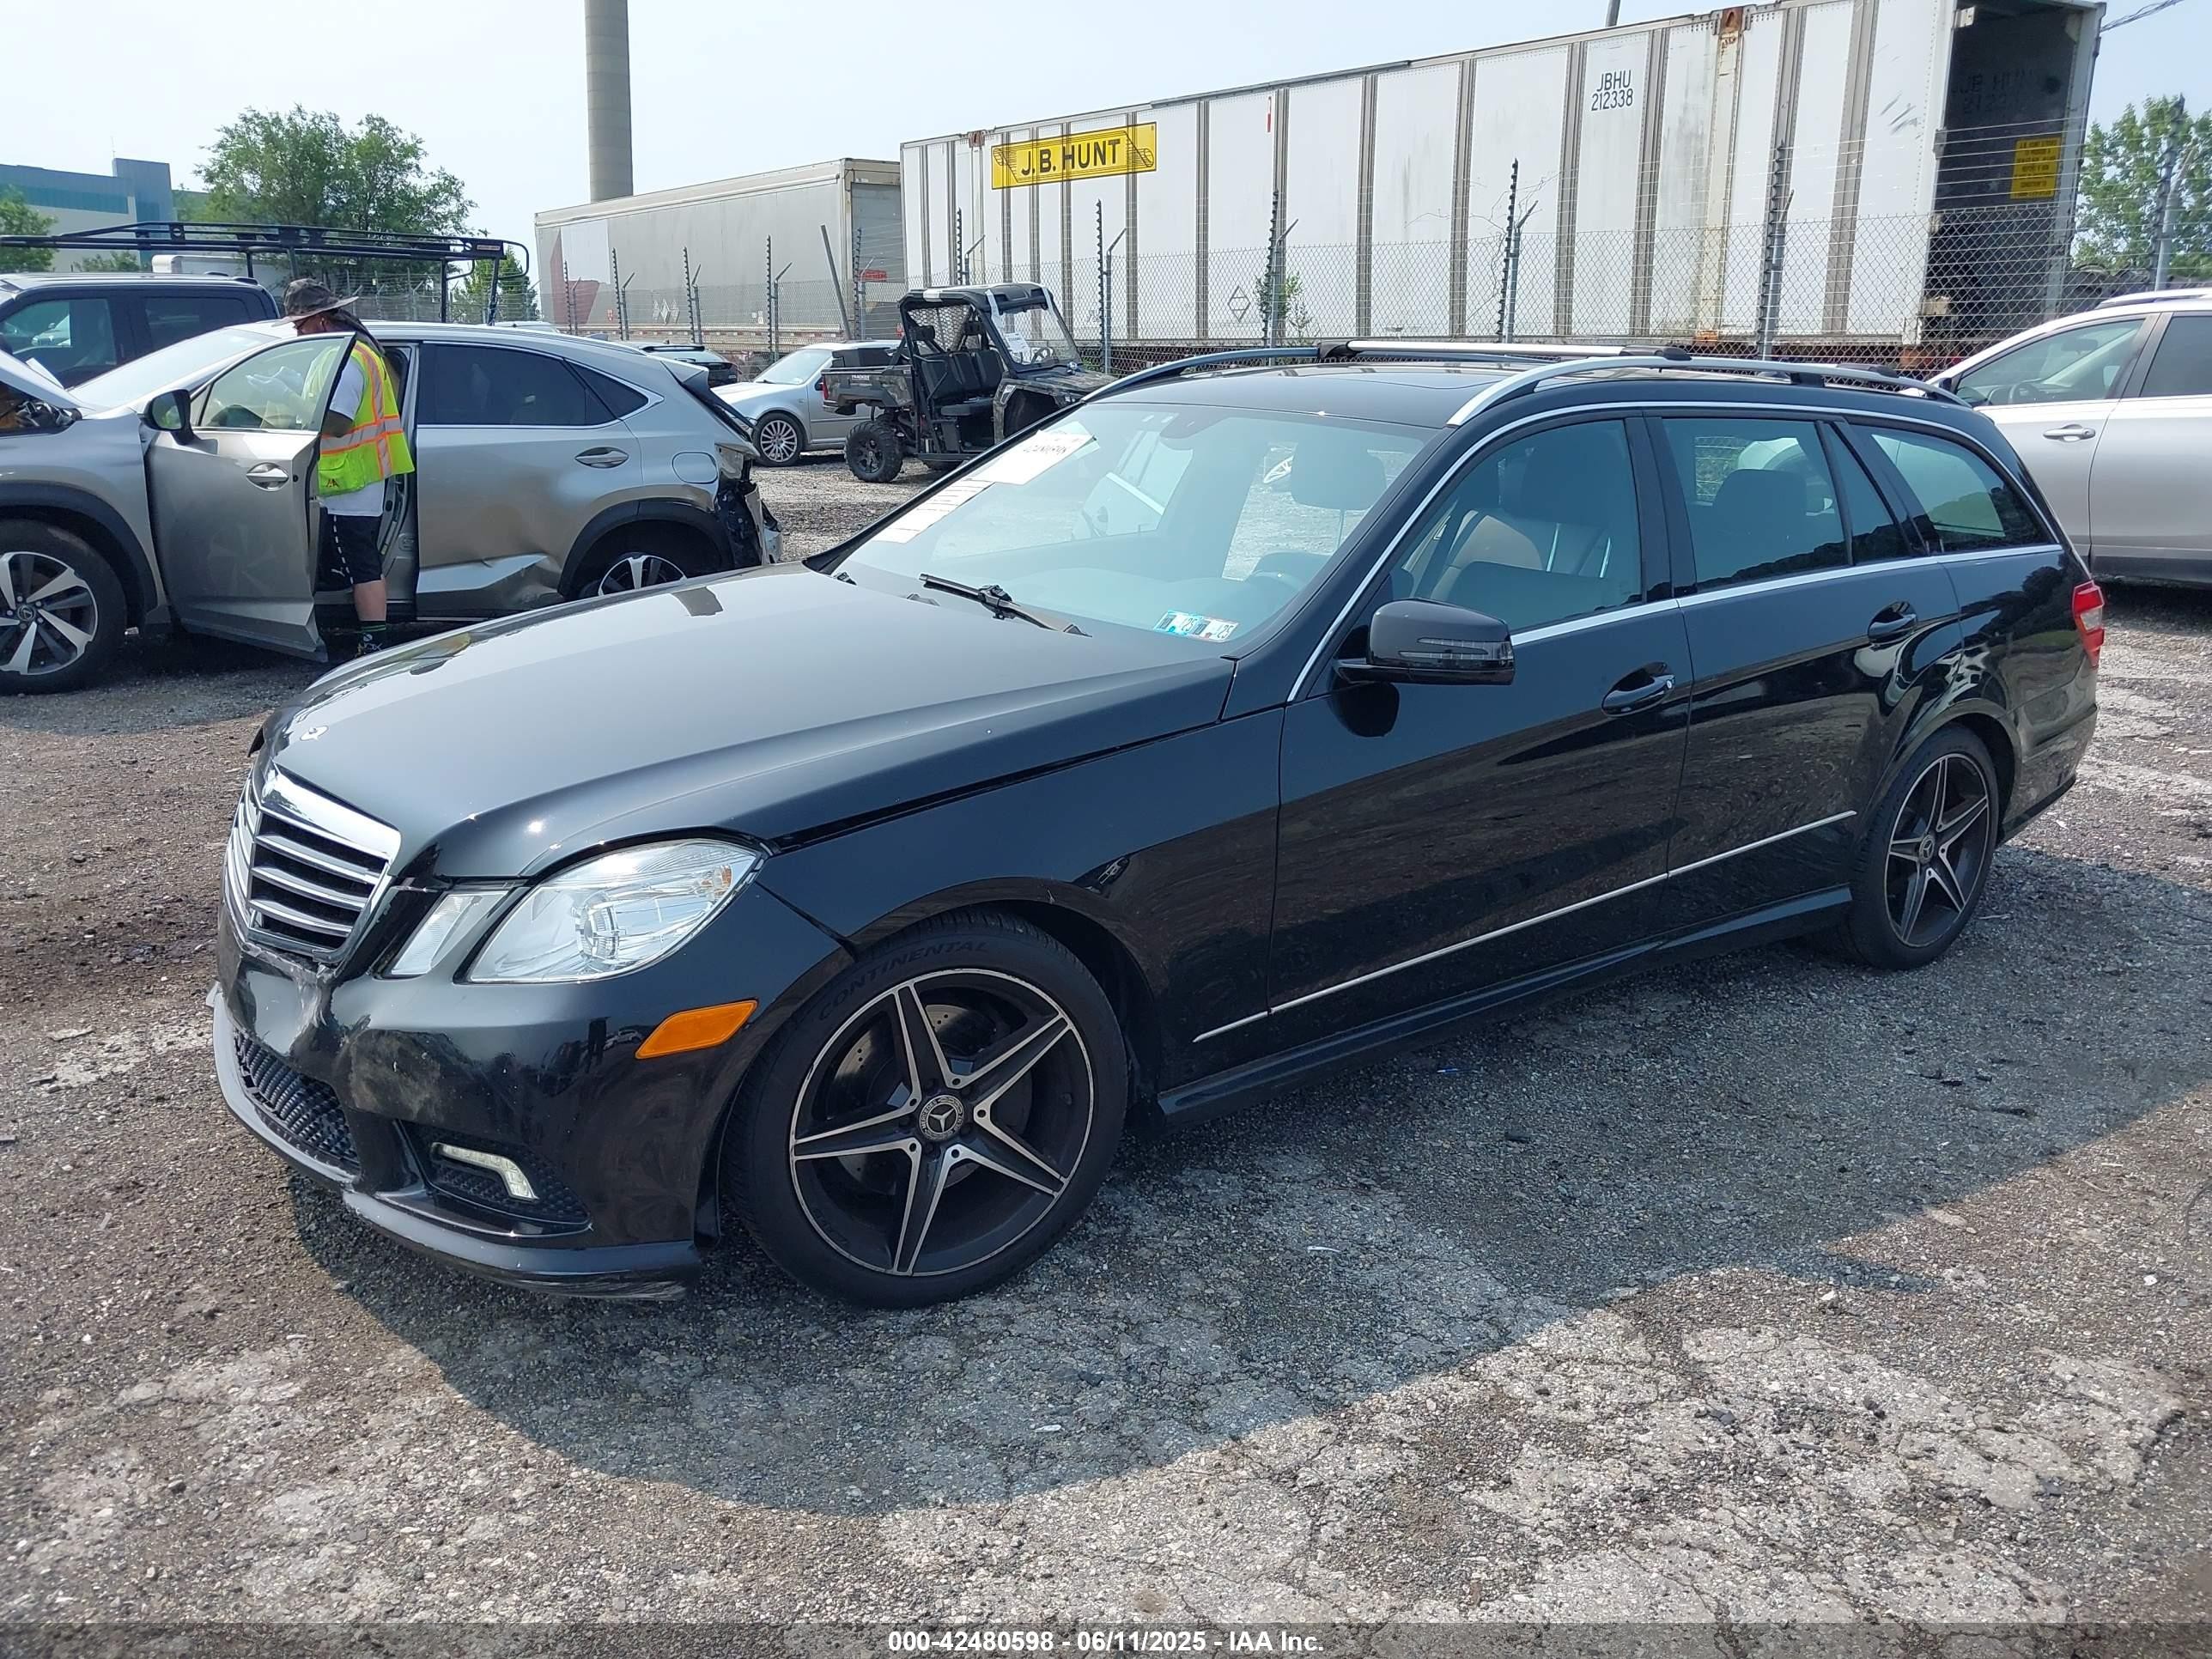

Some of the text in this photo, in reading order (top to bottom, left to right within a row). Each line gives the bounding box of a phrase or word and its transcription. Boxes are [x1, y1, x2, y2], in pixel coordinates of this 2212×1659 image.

[1596, 70, 1632, 92] JBHU
[1591, 88, 1633, 111] 212338
[1062, 139, 1121, 170] HUNT
[818, 941, 988, 1022] CONTINENTAL
